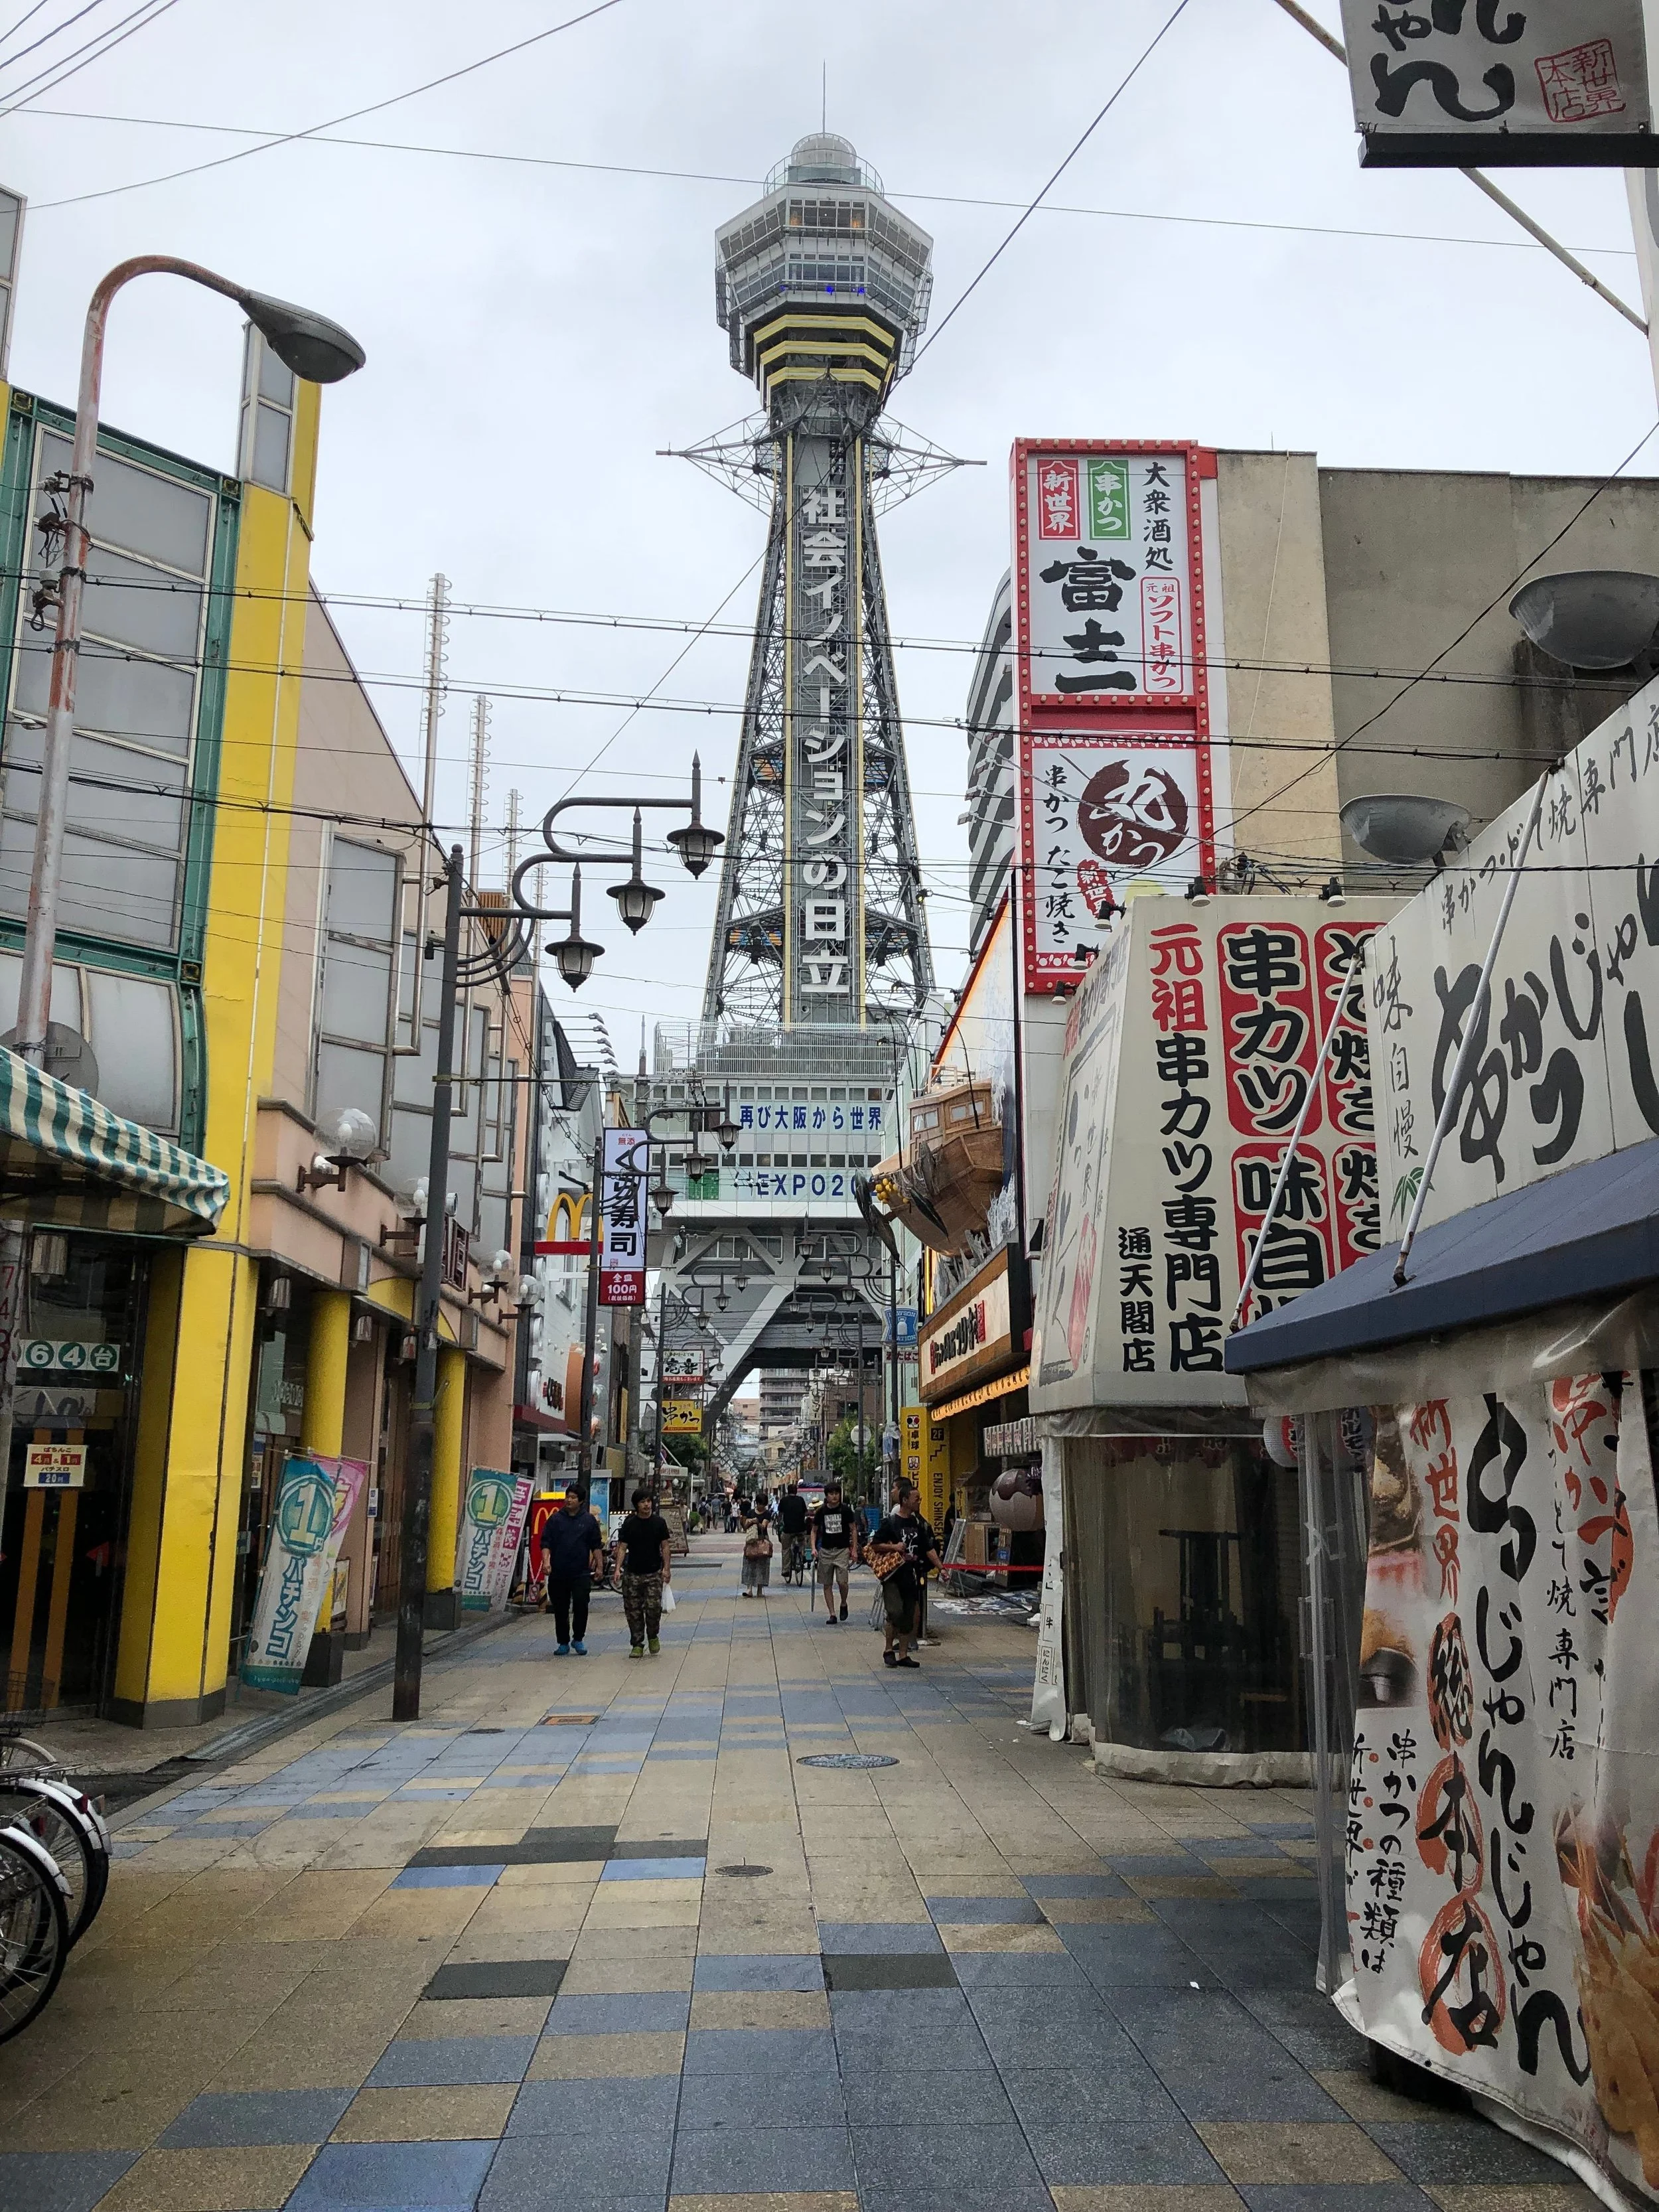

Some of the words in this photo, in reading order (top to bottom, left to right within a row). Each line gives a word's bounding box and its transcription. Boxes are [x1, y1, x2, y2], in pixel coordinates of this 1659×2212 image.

[1542, 57, 1583, 120] 本店
[1571, 44, 1622, 112] 新世界
[1043, 470, 1074, 535] 新世界
[1094, 471, 1123, 532] 串かつ
[1141, 461, 1174, 571] 大衆酒処
[1146, 583, 1175, 594] 元祖
[1149, 596, 1176, 689] ソフト串かつ
[801, 486, 850, 995] 社会イノベーションの日立
[1043, 764, 1068, 834] 串かつ
[1045, 845, 1076, 944] たこ焼き
[1227, 928, 1309, 1130] 串カツ
[1372, 935, 1419, 1159] 味自慢
[740, 1105, 882, 1130] 再び大阪から世界
[1149, 922, 1225, 1374] 元祖串カツ専門店
[757, 1173, 877, 1197] EXPO20
[1239, 1149, 1328, 1323] 味自
[607, 1284, 637, 1294] 100円
[613, 1274, 632, 1282] 全皿
[1118, 1225, 1155, 1373] 通天閣店
[662, 1402, 700, 1426] 串かつ
[911, 1430, 920, 1451] 卓球
[933, 1429, 943, 1439] 2F
[45, 1473, 64, 1483] 20円
[933, 1472, 944, 1499] ENJOY
[464, 1528, 494, 1591] パチンコ
[265, 1556, 308, 1660] パチンコ
[1045, 1615, 1054, 1629] 牛
[1042, 1649, 1050, 1683] にんにく
[1359, 1728, 1418, 1976] 串かつの種類は
